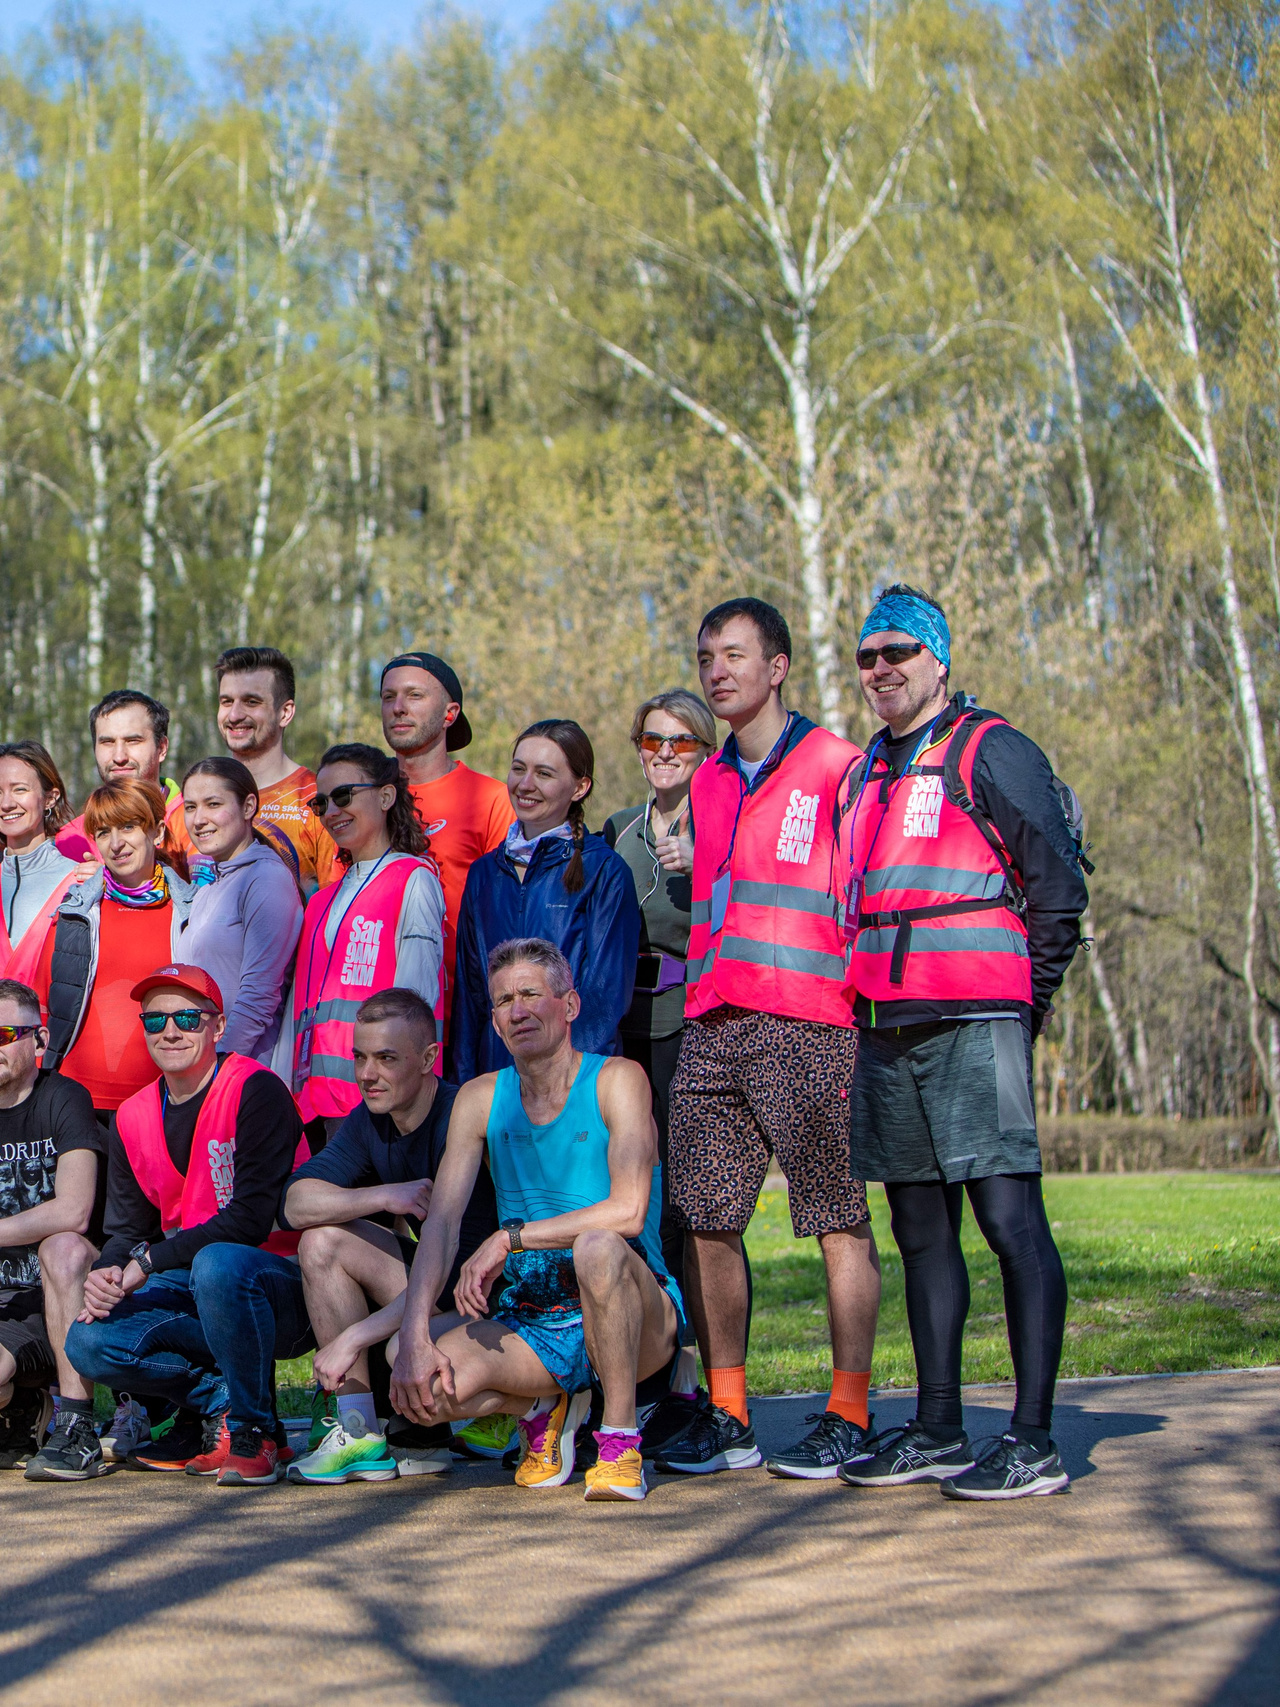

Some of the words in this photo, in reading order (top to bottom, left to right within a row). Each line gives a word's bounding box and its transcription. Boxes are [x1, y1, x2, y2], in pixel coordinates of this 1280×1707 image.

[785, 789, 820, 821] Sat
[906, 793, 944, 815] 9AM
[780, 817, 816, 843] 9AM
[903, 814, 939, 838] 5KM
[776, 838, 812, 865] 5KM
[349, 915, 384, 946] Sat
[345, 942, 379, 966] 9AM
[340, 963, 375, 988] 5KM
[210, 1165, 235, 1189] 9A
